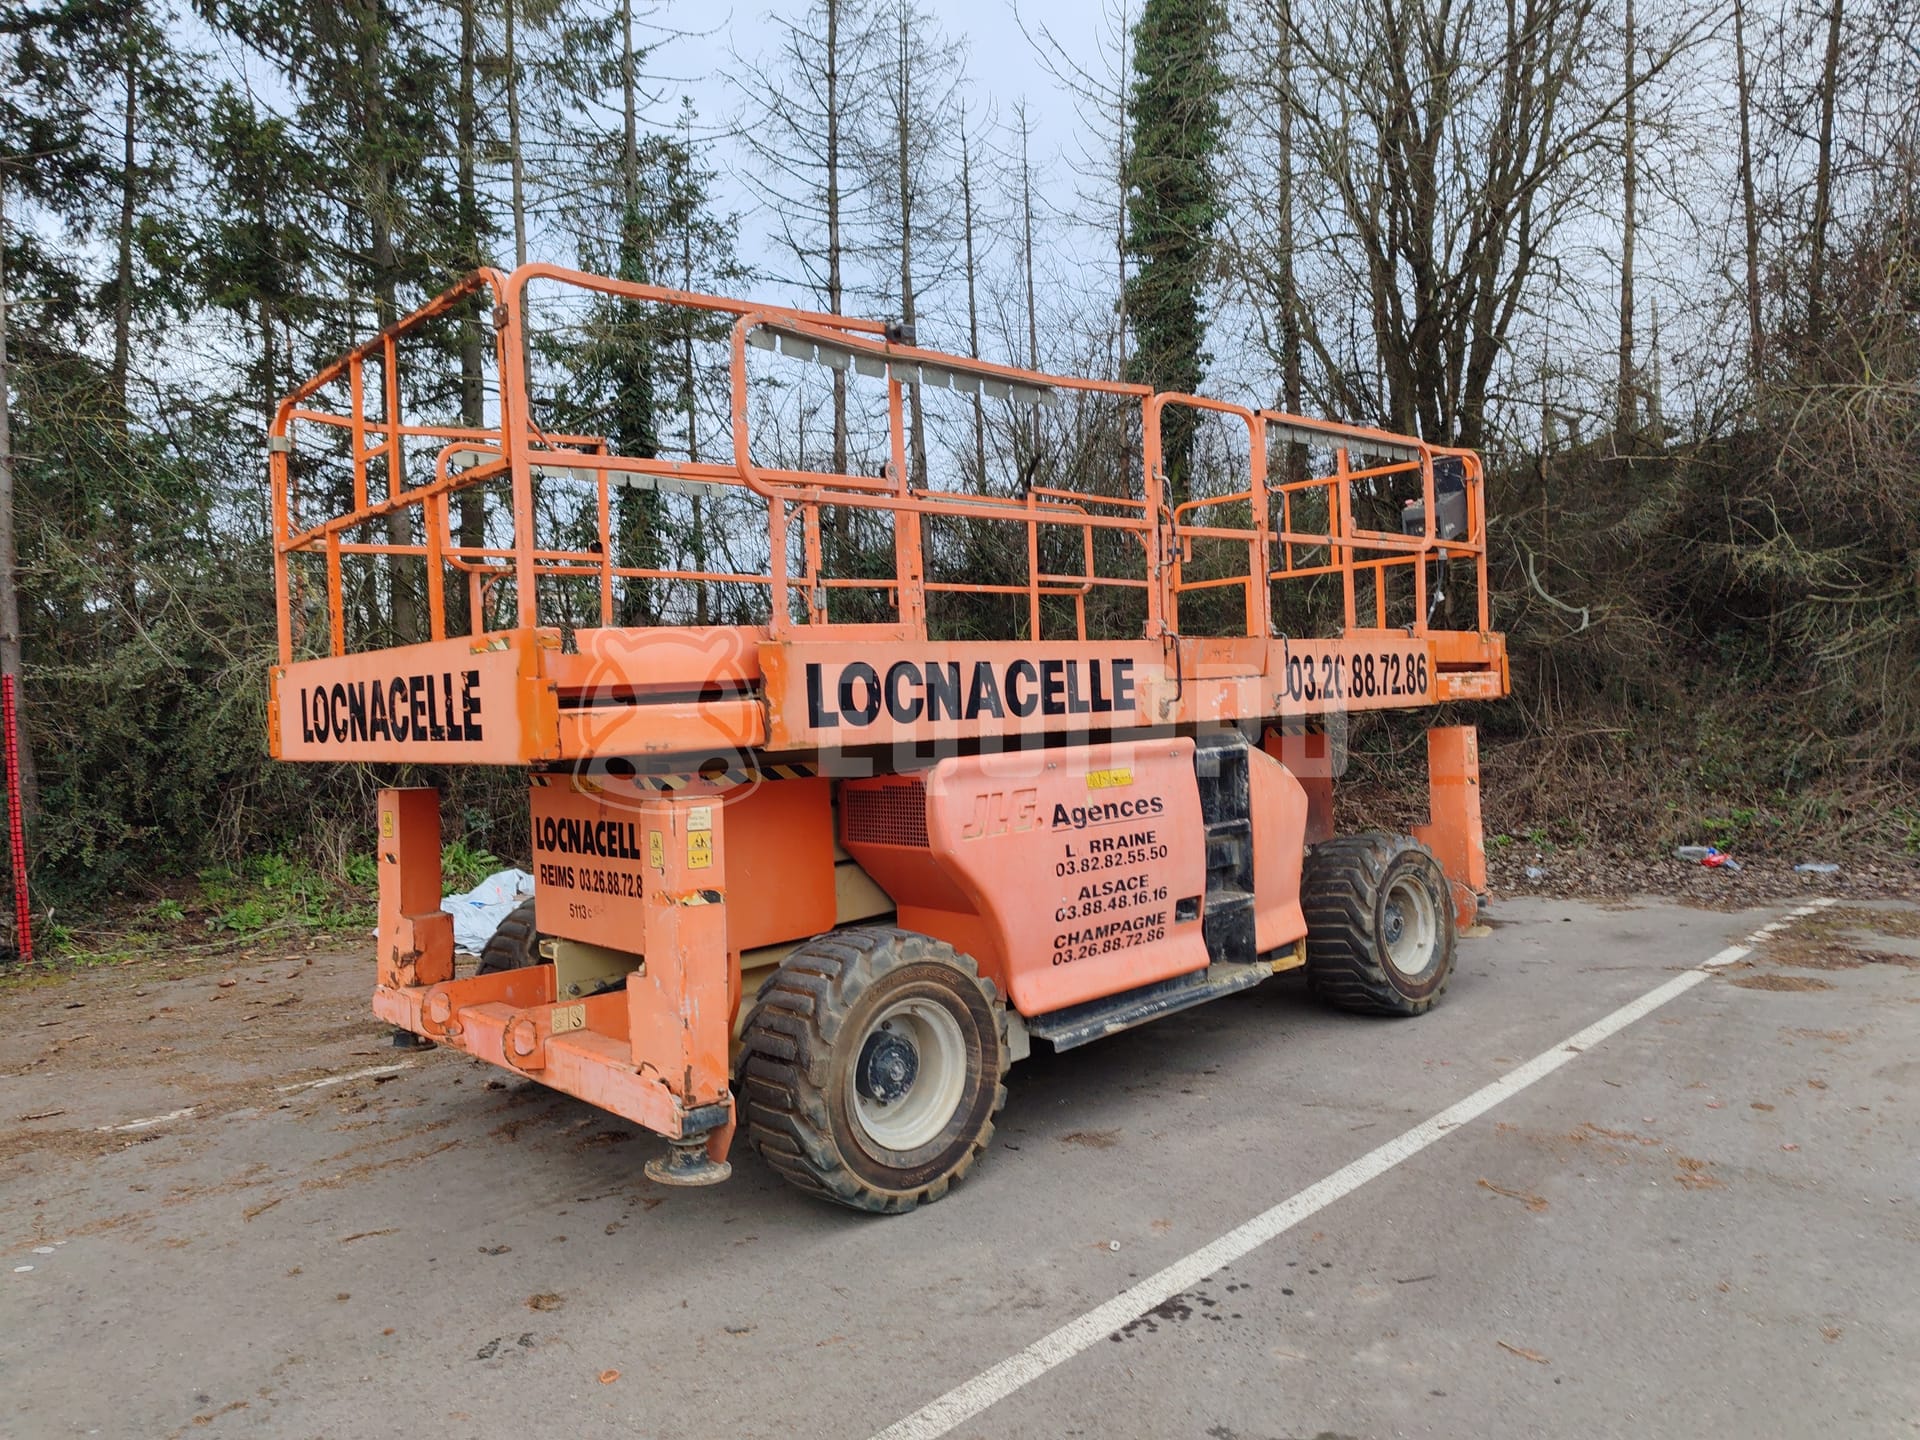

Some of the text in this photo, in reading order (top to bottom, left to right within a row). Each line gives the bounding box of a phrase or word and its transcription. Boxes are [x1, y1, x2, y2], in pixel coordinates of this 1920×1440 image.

[301, 670, 483, 743] LOCNACELLE
[805, 658, 1136, 728] LOCNACELLE
[1052, 797, 1164, 830] Agences
[535, 816, 641, 860] LOCNACELL
[1065, 831, 1156, 858] LRRAINE
[1055, 845, 1168, 877] 03.82.82.55.50
[540, 863, 643, 899] REIMS 03.26.88.72.8
[1078, 874, 1149, 901] ALSACE
[1055, 886, 1168, 922] 03.88.48.16.16
[1052, 927, 1165, 966] 03.26.88.72.86
[1053, 911, 1167, 949] CHAMPAGNE
